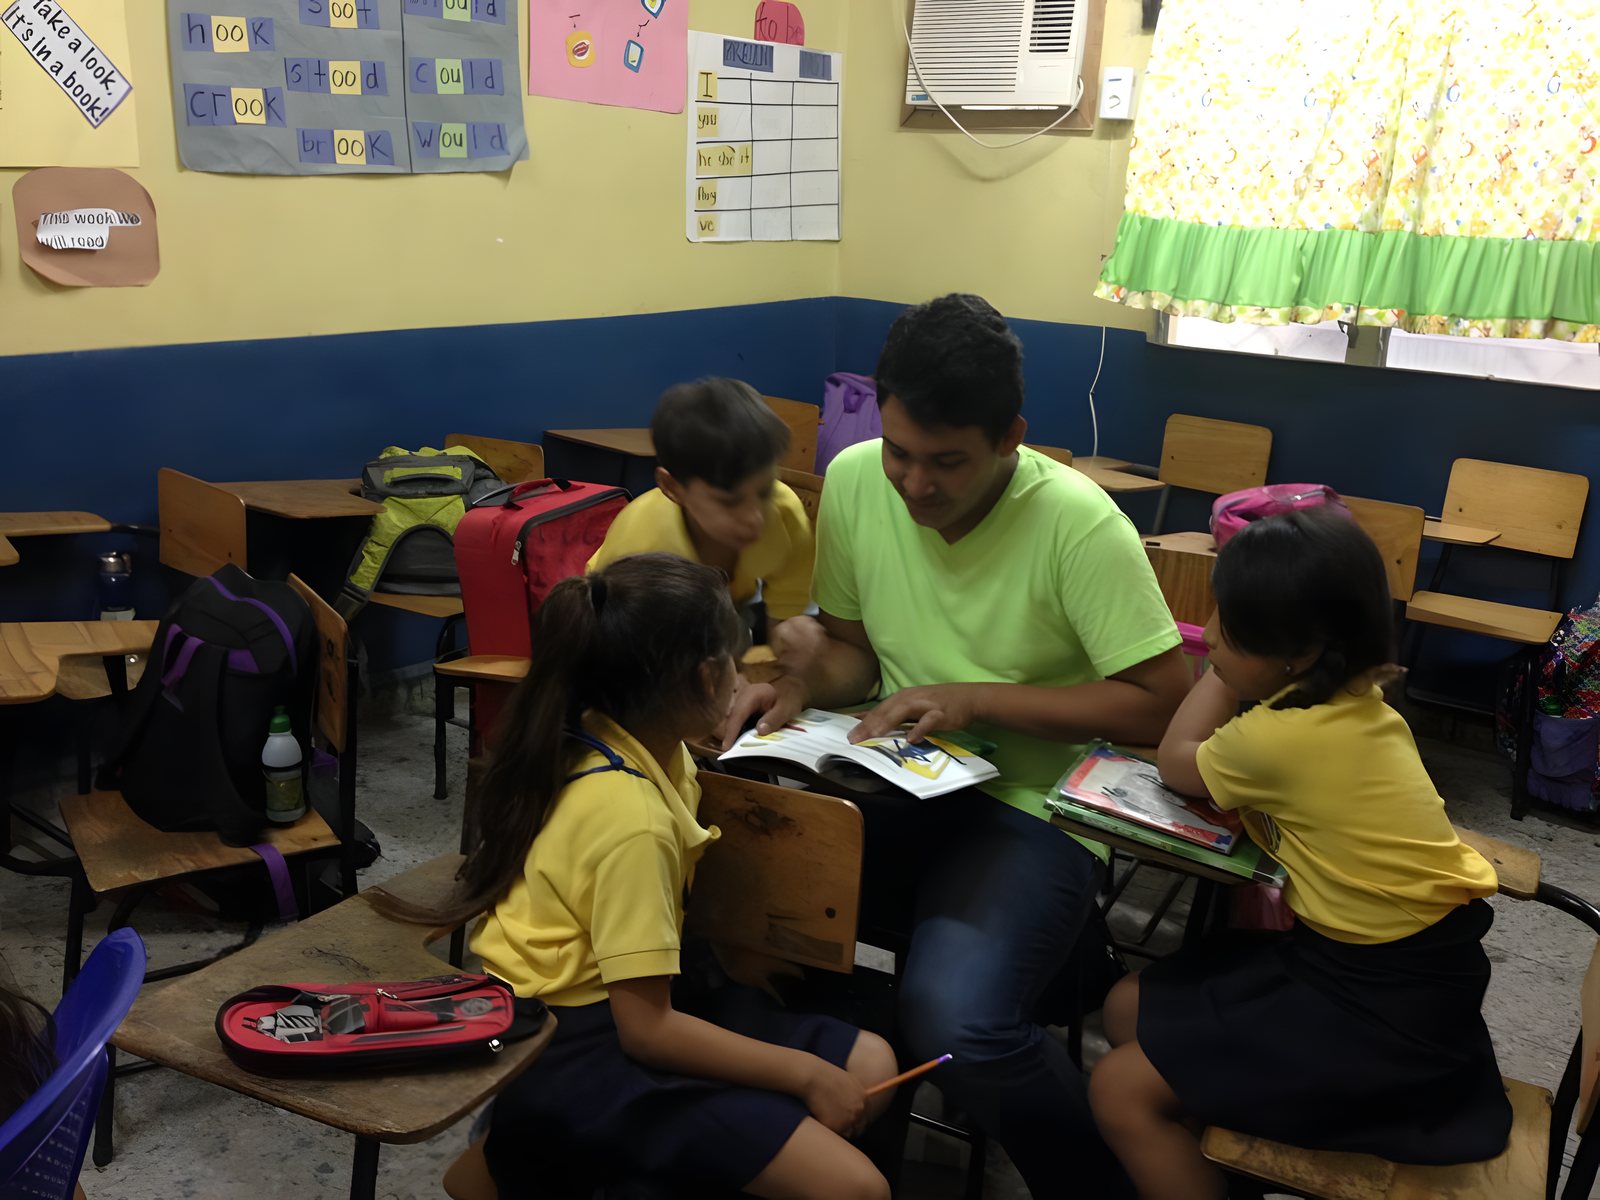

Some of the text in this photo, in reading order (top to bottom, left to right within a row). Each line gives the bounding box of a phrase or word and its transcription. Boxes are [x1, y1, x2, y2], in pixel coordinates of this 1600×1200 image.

[49, 60, 64, 76] a
[62, 70, 109, 123] book!
[67, 37, 82, 54] a
[80, 46, 116, 96] look,
[290, 59, 380, 89] stood
